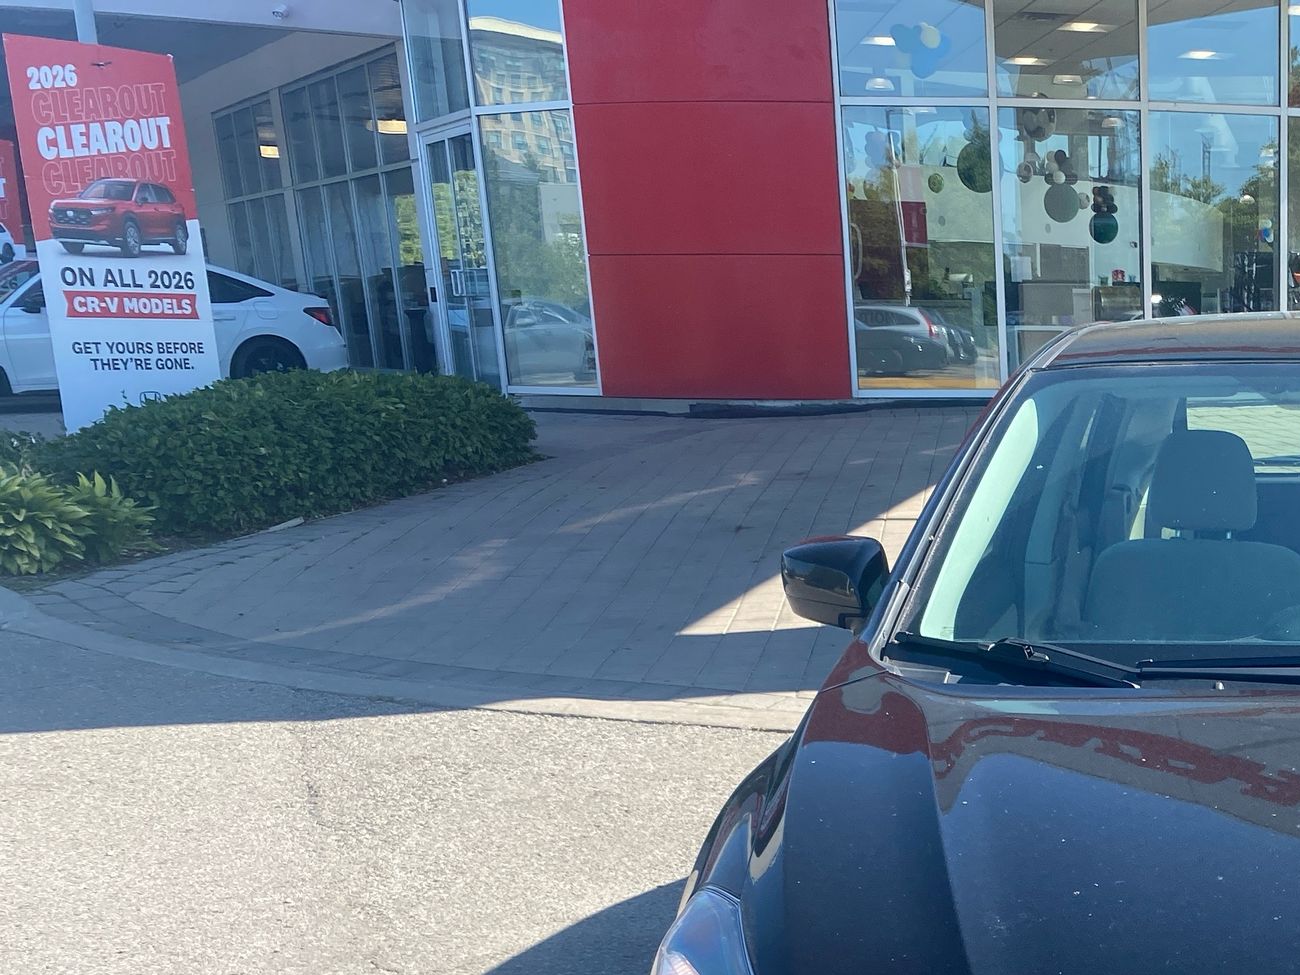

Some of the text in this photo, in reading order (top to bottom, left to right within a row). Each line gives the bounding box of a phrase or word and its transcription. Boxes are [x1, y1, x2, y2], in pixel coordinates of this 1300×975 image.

[26, 64, 78, 90] 2026
[31, 83, 166, 125] CLEAROUT
[37, 117, 171, 160] CLEAROUT
[42, 150, 177, 195] CLEAROUT
[60, 266, 195, 290] ON ALL 2026
[73, 296, 193, 315] CR-V MODELS
[71, 341, 205, 355] GET YOURS BEFORE
[90, 358, 195, 371] THEY'RE GONE.
